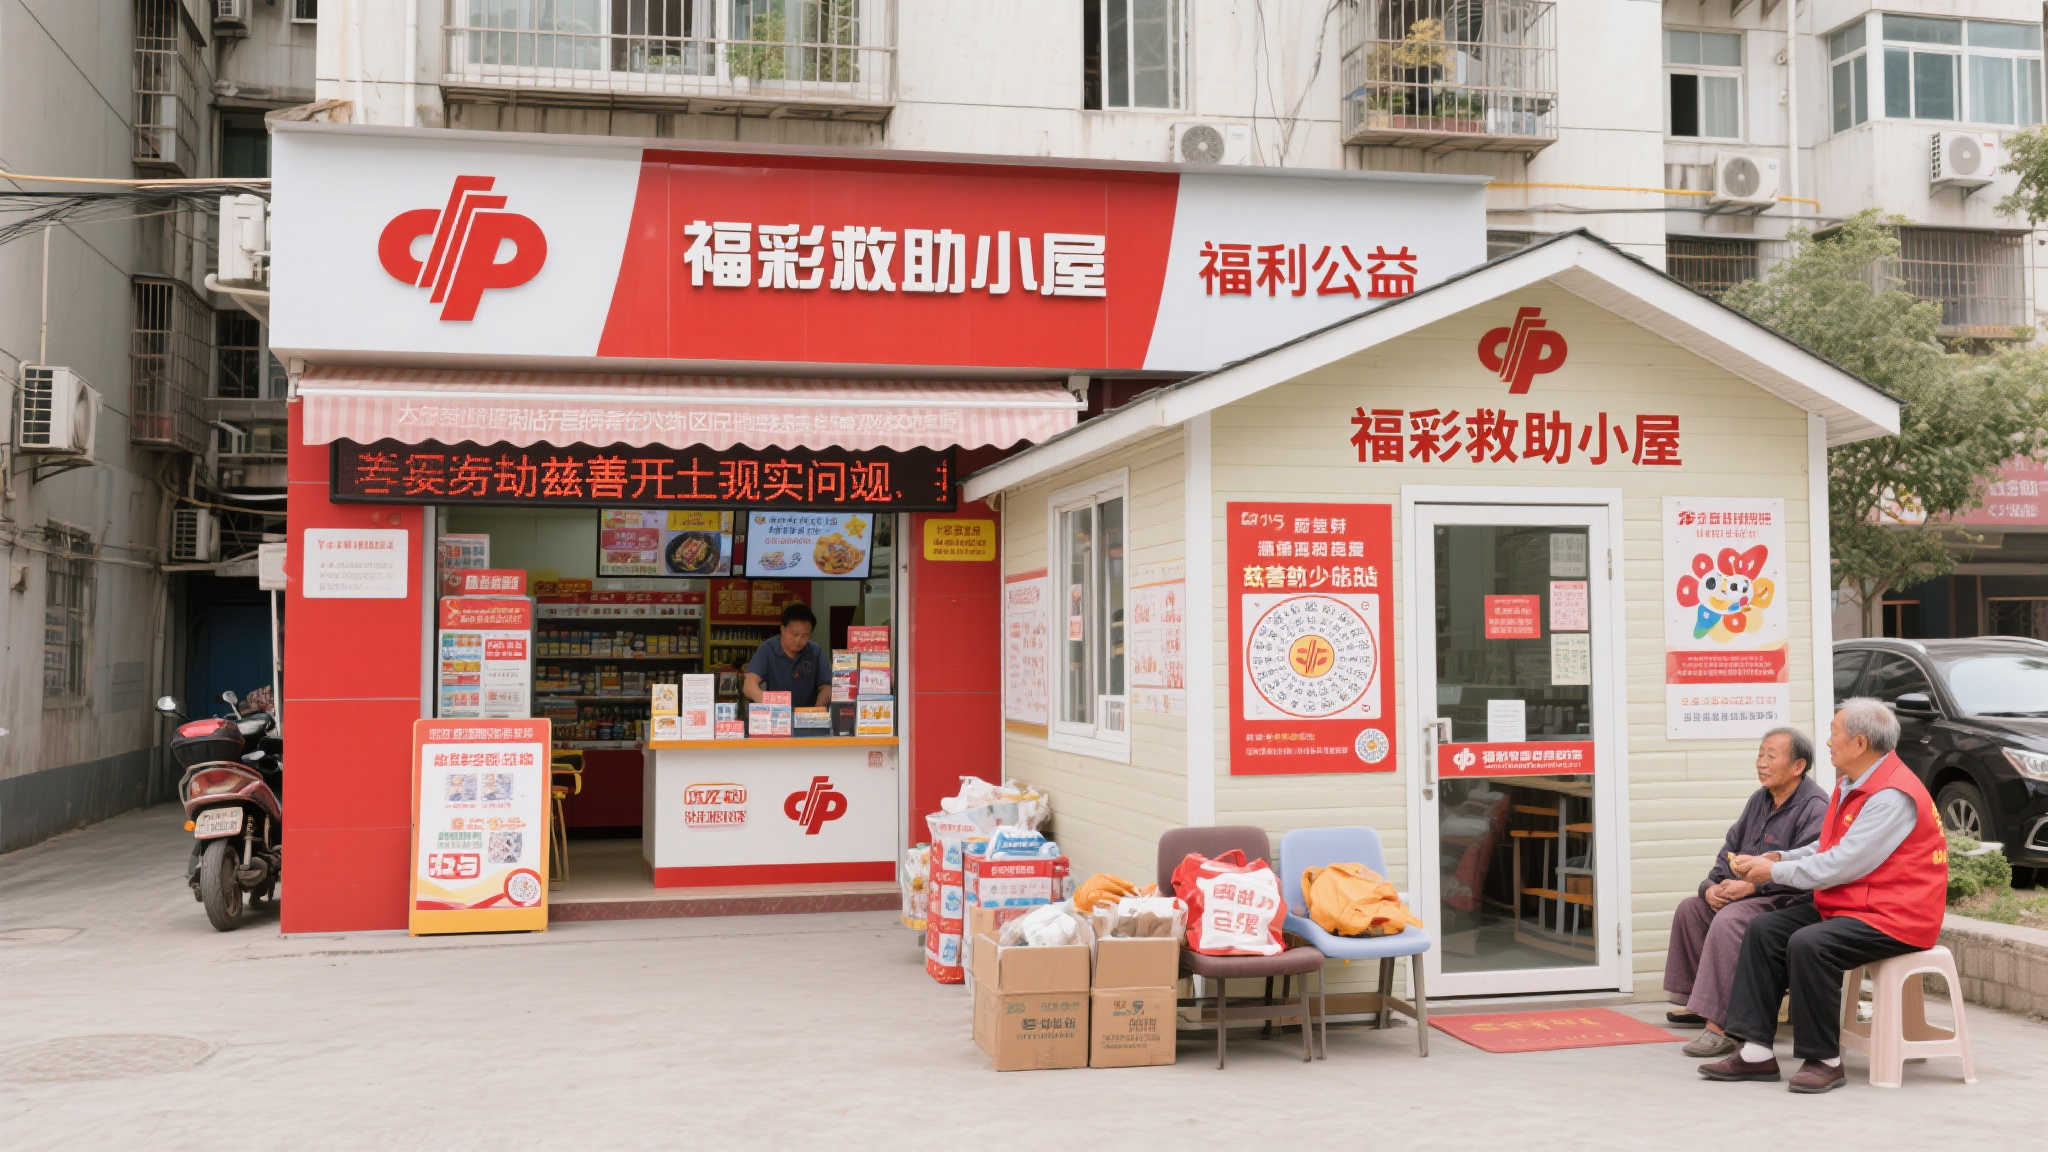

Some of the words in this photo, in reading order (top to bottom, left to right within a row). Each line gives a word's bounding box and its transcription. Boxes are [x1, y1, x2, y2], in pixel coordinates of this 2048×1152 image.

[683, 220, 1106, 297] 福彩救助小屋
[1199, 241, 1418, 299] 福利公益
[1350, 406, 1683, 466] 福彩救助小屋
